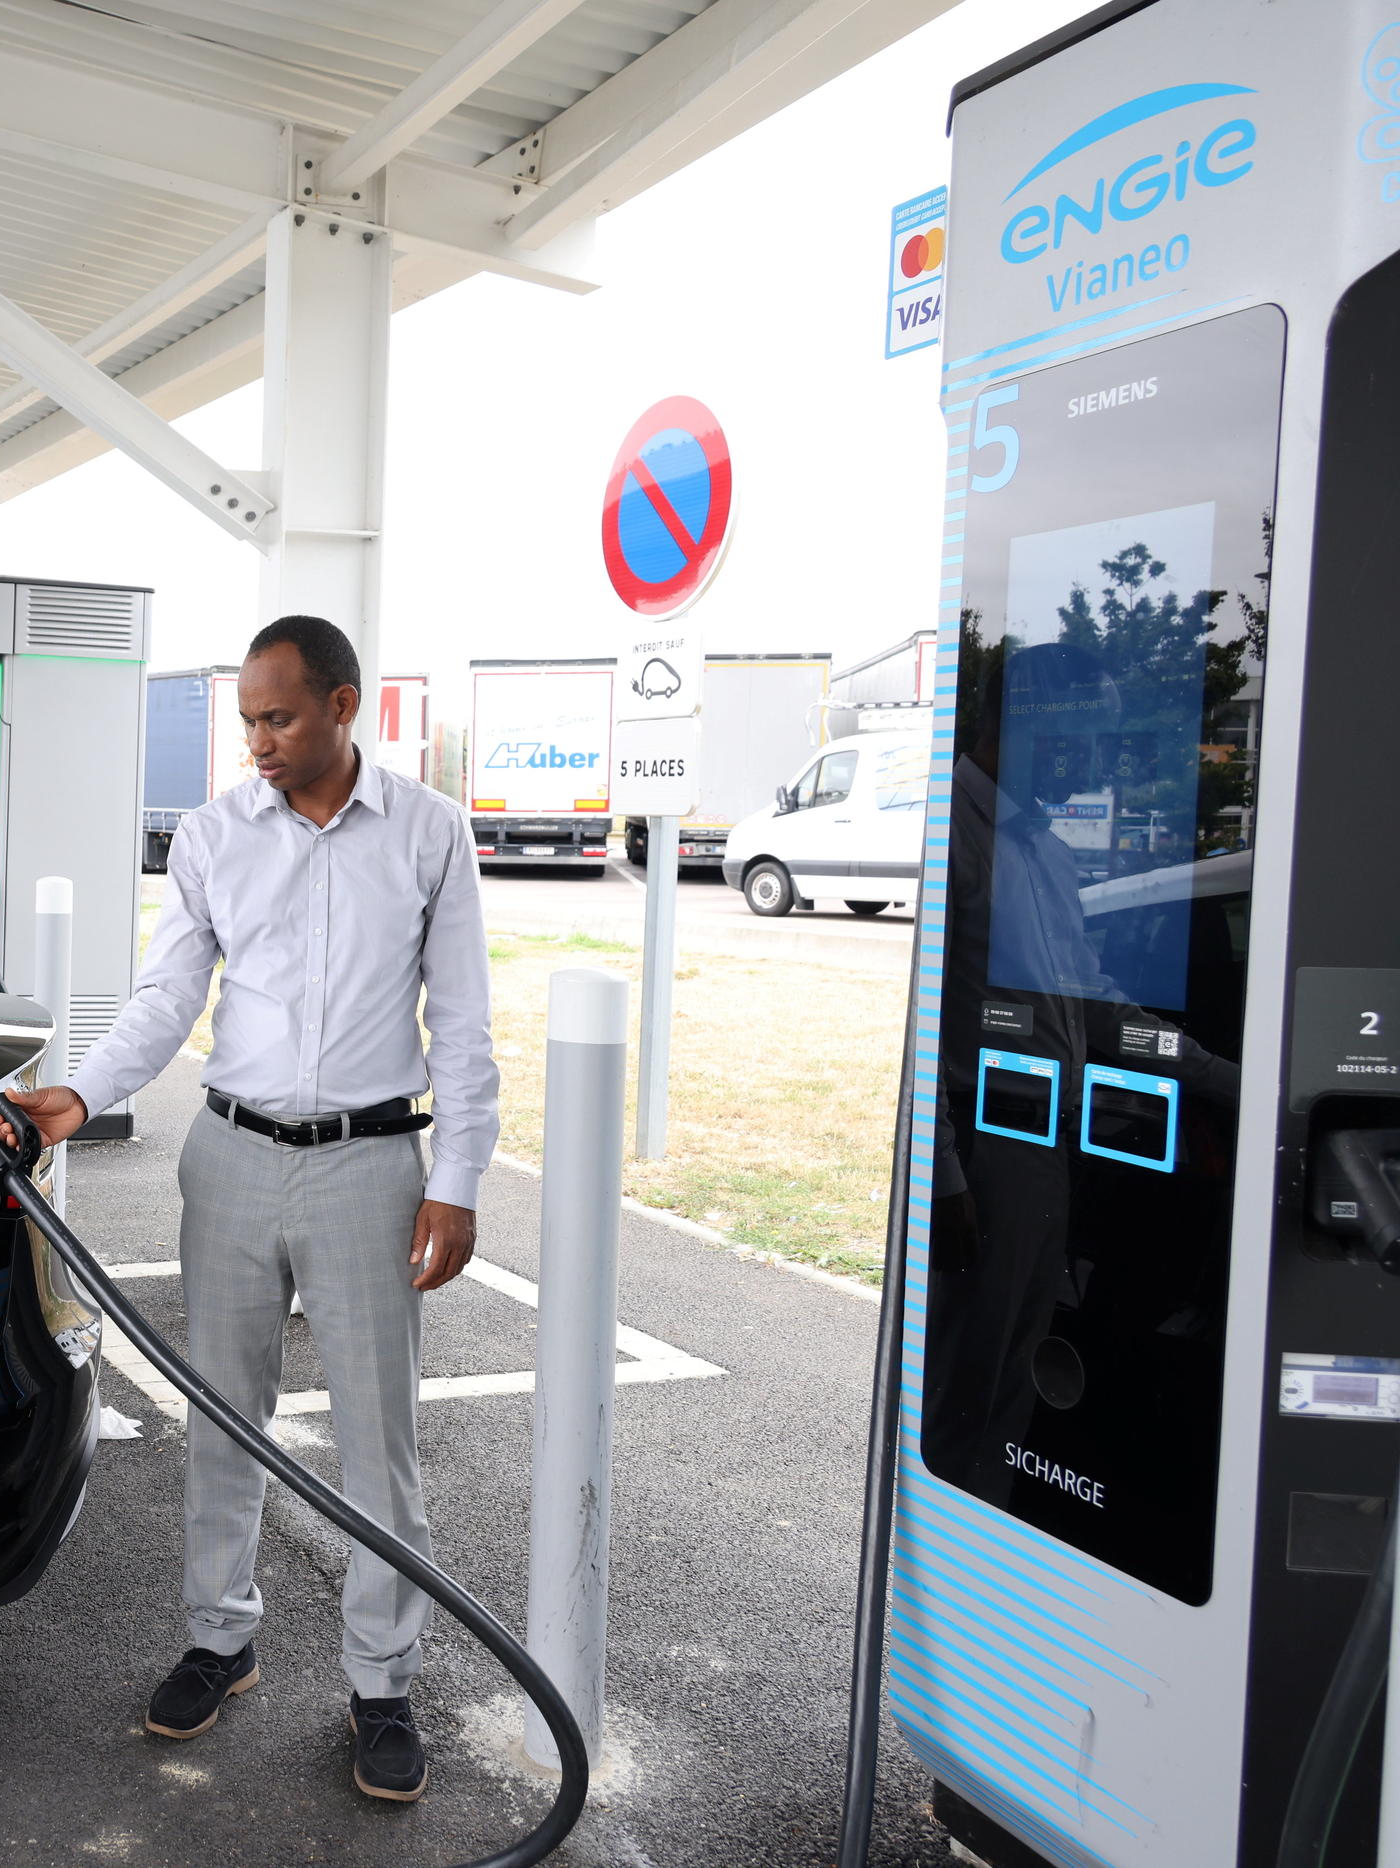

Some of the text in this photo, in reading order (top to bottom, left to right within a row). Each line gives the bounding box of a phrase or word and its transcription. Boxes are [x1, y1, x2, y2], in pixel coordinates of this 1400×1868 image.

[1046, 233, 1190, 313] Vianeo
[895, 293, 941, 331] VISA
[1066, 376, 1158, 419] SIEMENS
[969, 384, 1020, 494] 5
[632, 639, 684, 654] INTERDIT SAUF
[1008, 704, 1034, 715] SELECT
[1036, 702, 1077, 713] CHARGING
[484, 742, 600, 769] Huber
[620, 758, 685, 777] 5 PLACES
[1360, 1011, 1379, 1035] 2
[1336, 1064, 1397, 1074] 102114-05-2
[1004, 1442, 1105, 1509] SICHARGE
